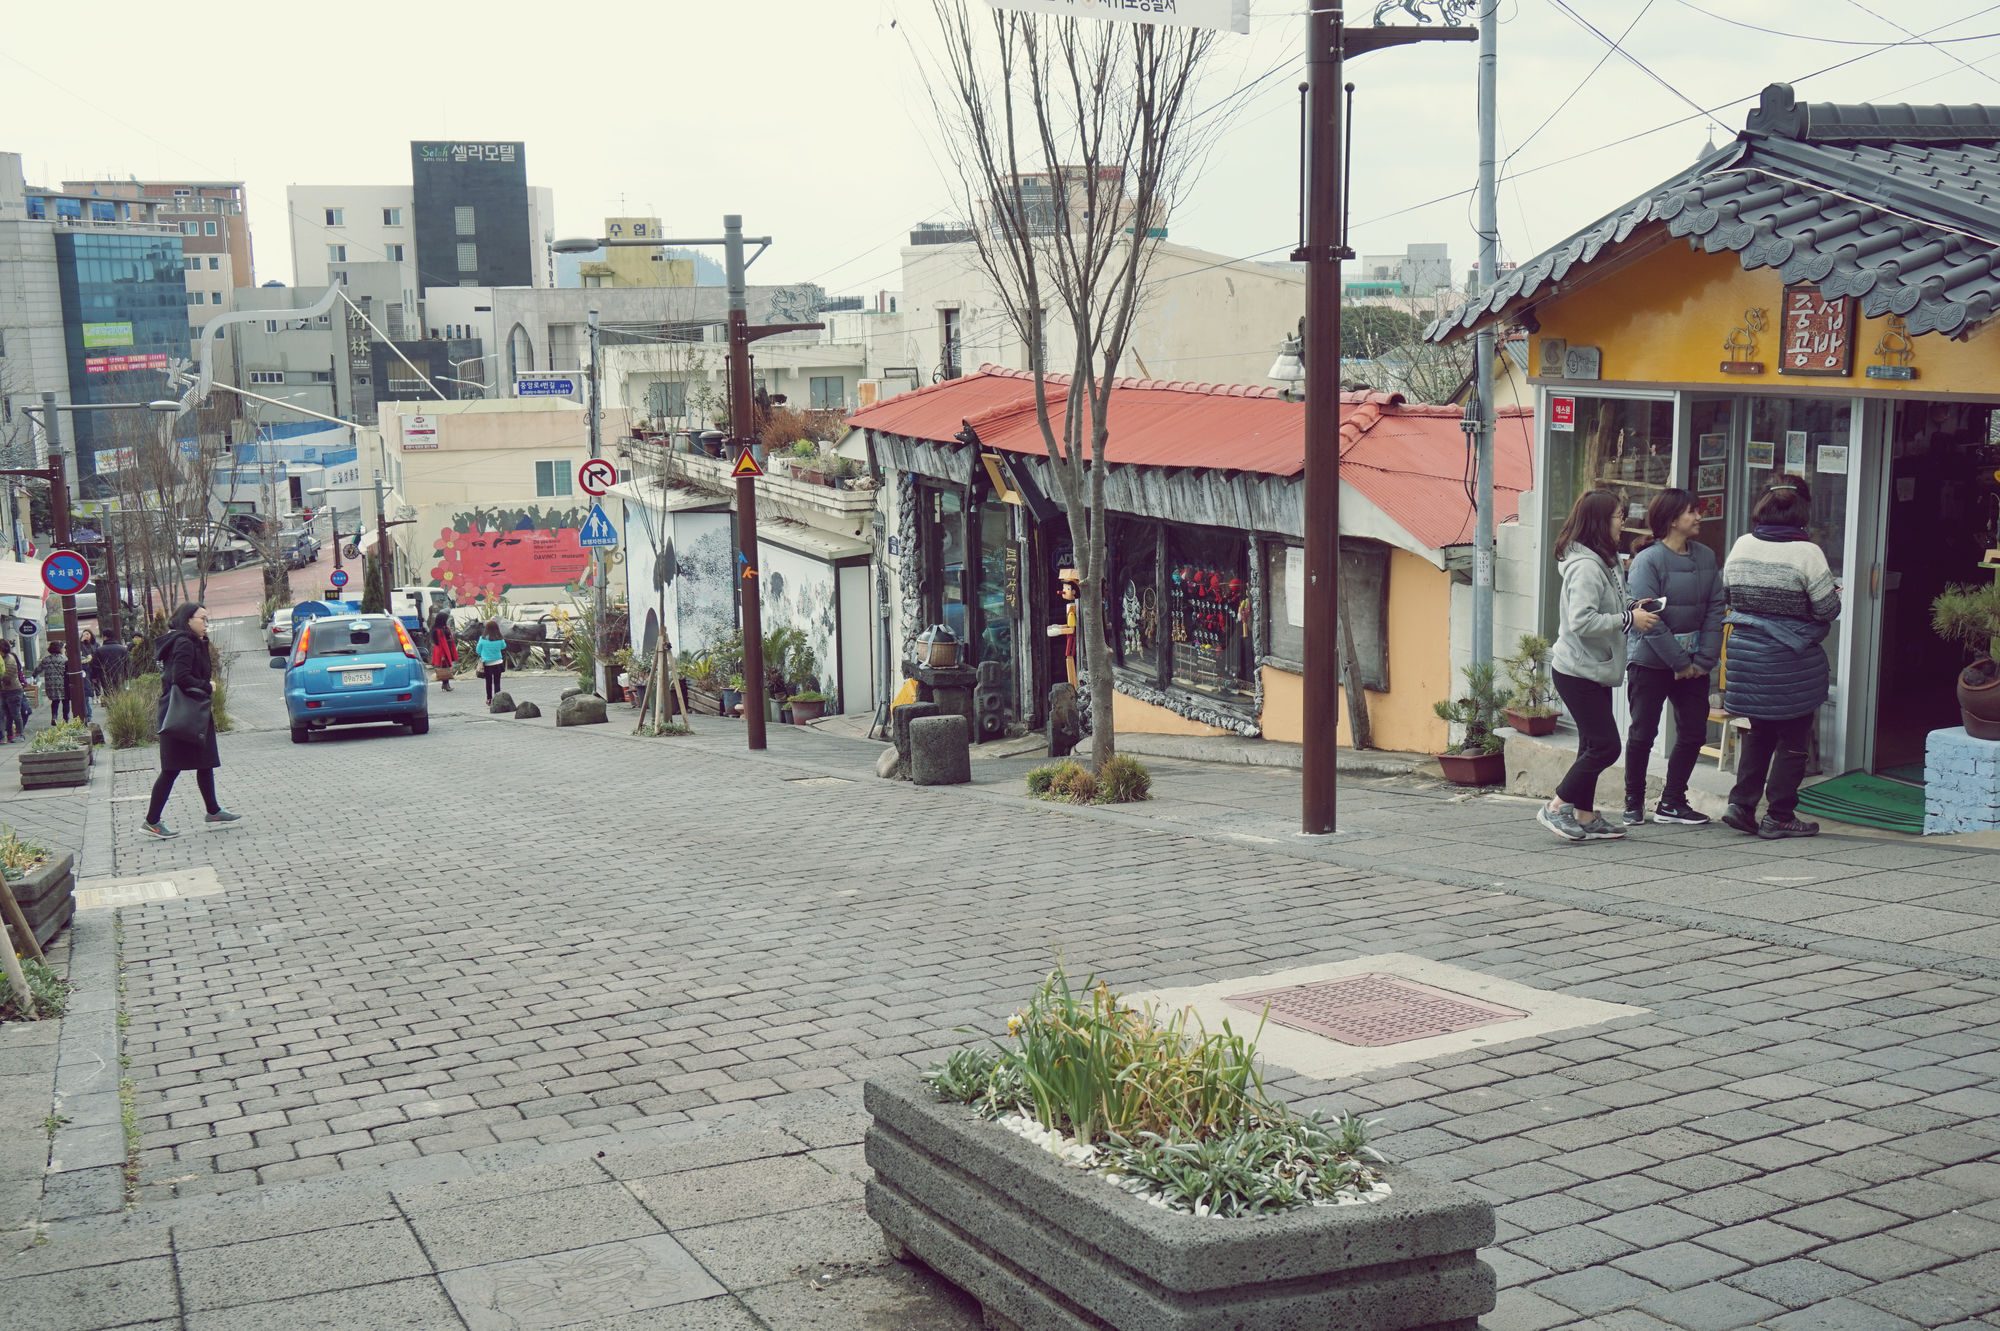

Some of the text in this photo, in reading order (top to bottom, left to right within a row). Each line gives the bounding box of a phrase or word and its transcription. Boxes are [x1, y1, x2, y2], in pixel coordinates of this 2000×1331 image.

[451, 144, 515, 162] 셀라모텔
[609, 223, 646, 237] 수협
[1789, 294, 1844, 331] 중섭
[349, 308, 371, 357] 竹林
[1787, 331, 1843, 367] 공방
[1056, 553, 1073, 566] AD
[49, 568, 83, 578] 주차금지
